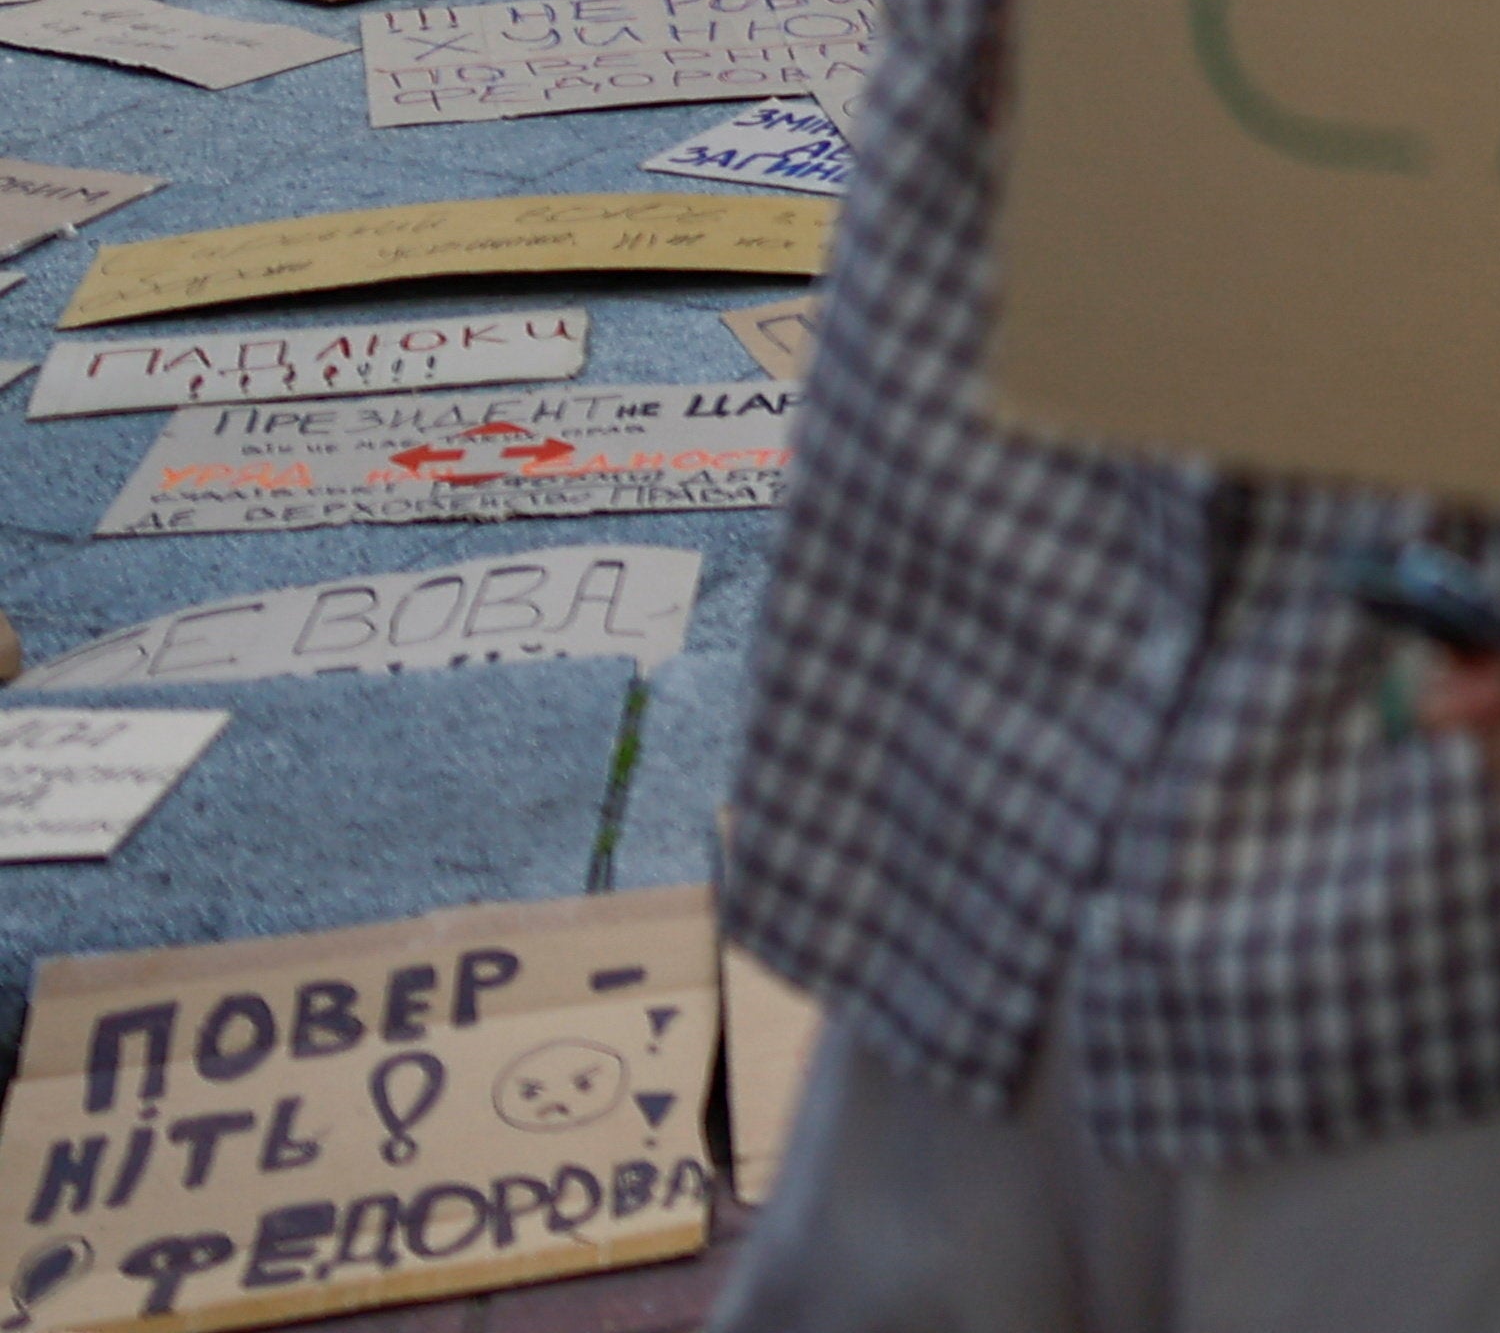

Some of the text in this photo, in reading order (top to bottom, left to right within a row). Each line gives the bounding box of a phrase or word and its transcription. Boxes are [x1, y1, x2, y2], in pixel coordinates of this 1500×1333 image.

[215, 395, 623, 435] ПРЕЗИДЕНТ
[84, 947, 521, 1113] ПОВЕР
[28, 1095, 323, 1225] НІТЬ
[119, 1156, 712, 1321] ФЕДОРОВА
